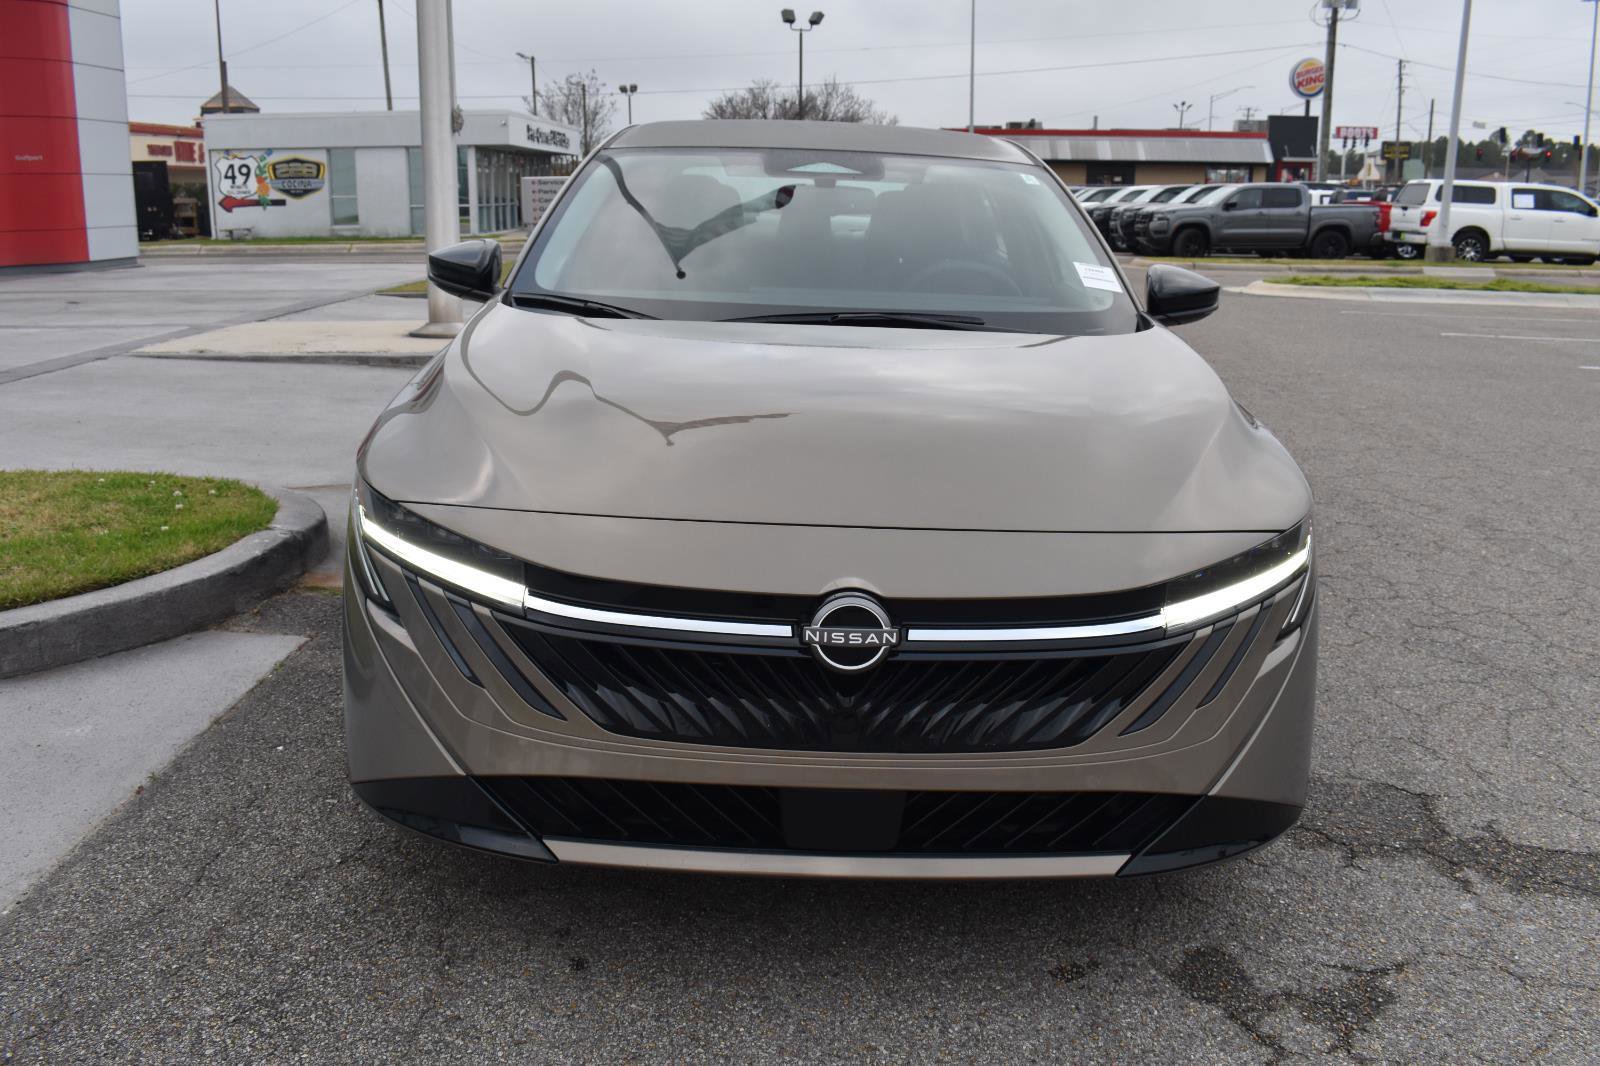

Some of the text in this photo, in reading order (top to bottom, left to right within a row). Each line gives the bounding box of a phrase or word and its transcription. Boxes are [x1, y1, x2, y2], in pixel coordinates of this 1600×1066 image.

[1296, 74, 1325, 89] KING
[224, 164, 251, 184] 49
[281, 180, 312, 188] COCINA
[805, 629, 897, 644] NISSAN
